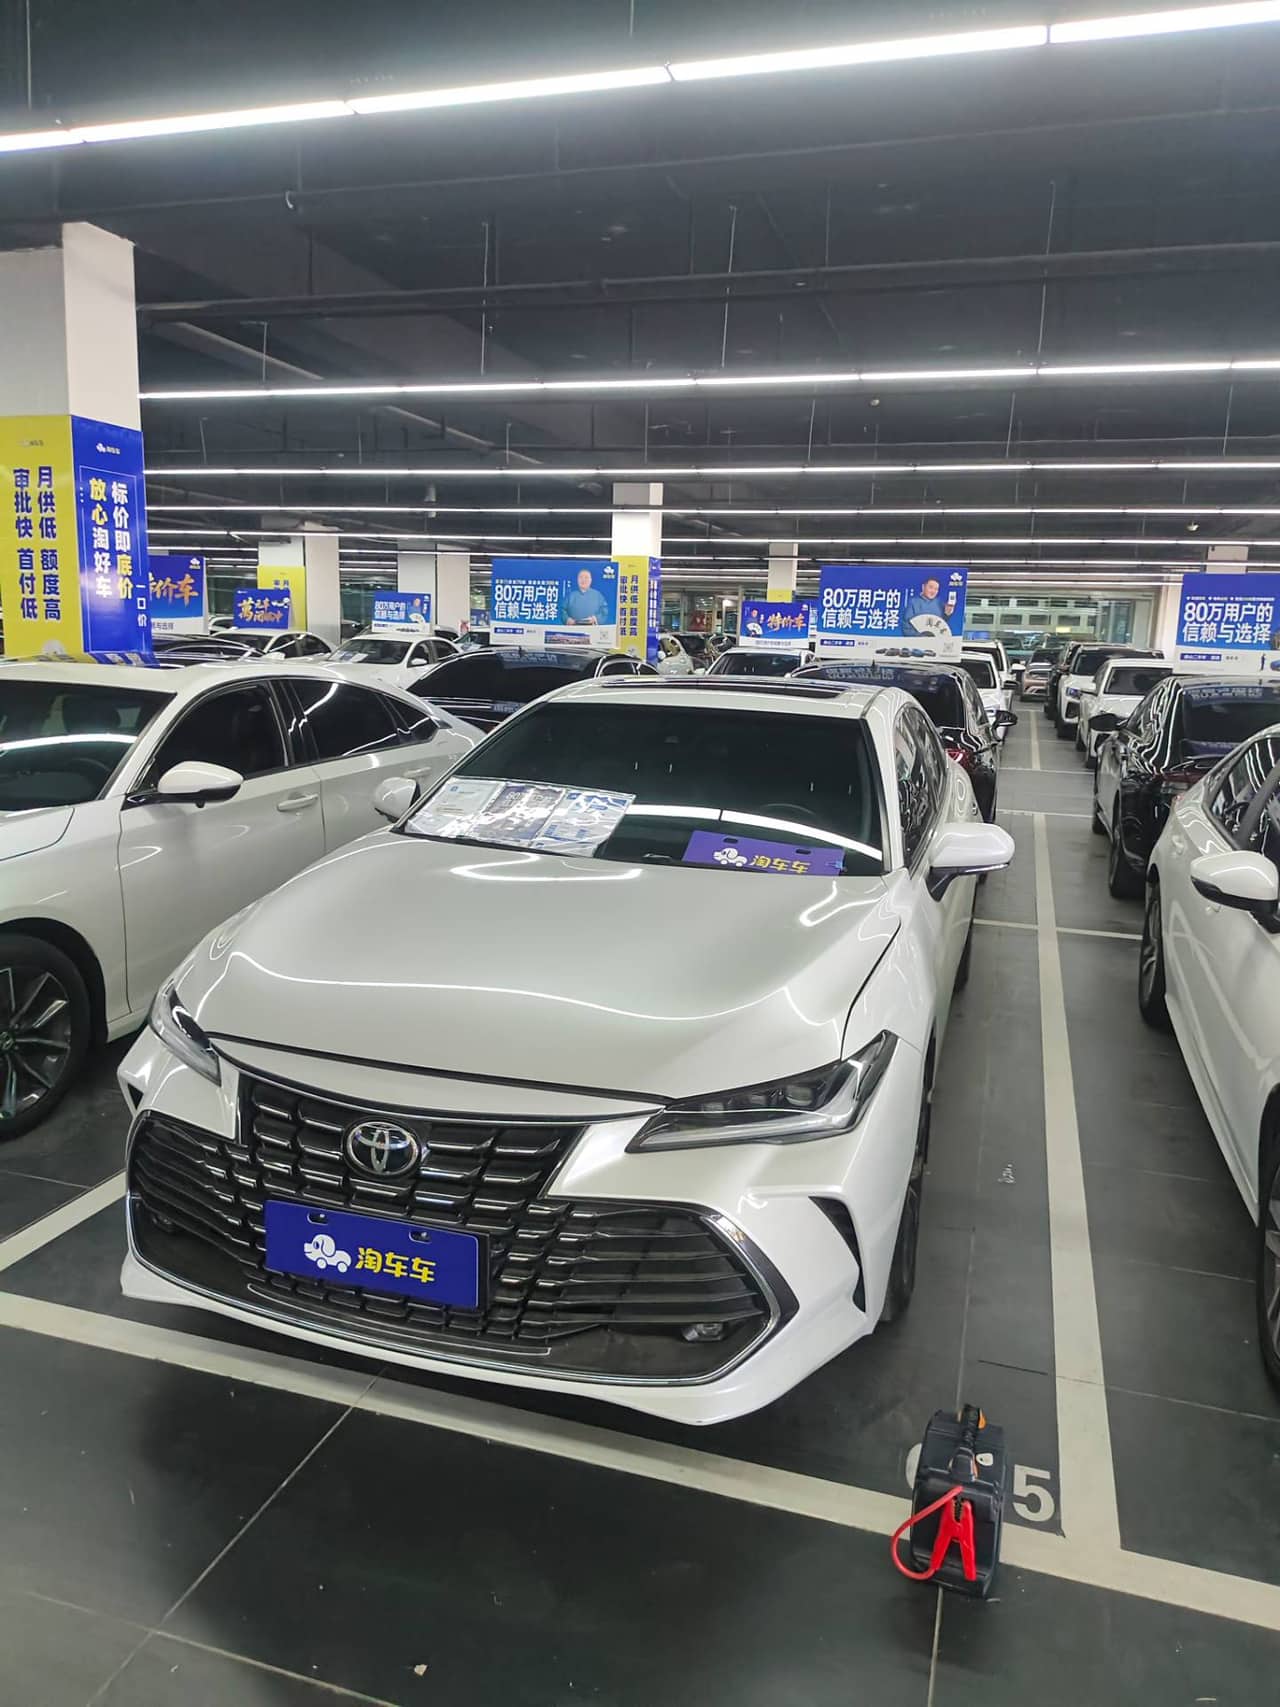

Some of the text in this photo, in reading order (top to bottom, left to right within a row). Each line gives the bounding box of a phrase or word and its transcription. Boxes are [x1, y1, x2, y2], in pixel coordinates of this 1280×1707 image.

[13, 468, 38, 621] 审批快 首付低
[37, 465, 62, 622] 月供低 额度高
[89, 476, 114, 600] 放心淘好车
[111, 480, 134, 601] 标价即底价
[494, 584, 559, 602] 80万用户的
[822, 587, 901, 609] 80万用户的
[135, 583, 148, 628] 一口价
[494, 602, 559, 621] 信赖与选择
[1183, 602, 1273, 623] 80万用户的
[821, 608, 900, 631] 信赖与选择
[1182, 622, 1271, 644] 信赖与选择
[749, 855, 811, 874] 淘车车
[355, 1246, 436, 1283] 淘车车
